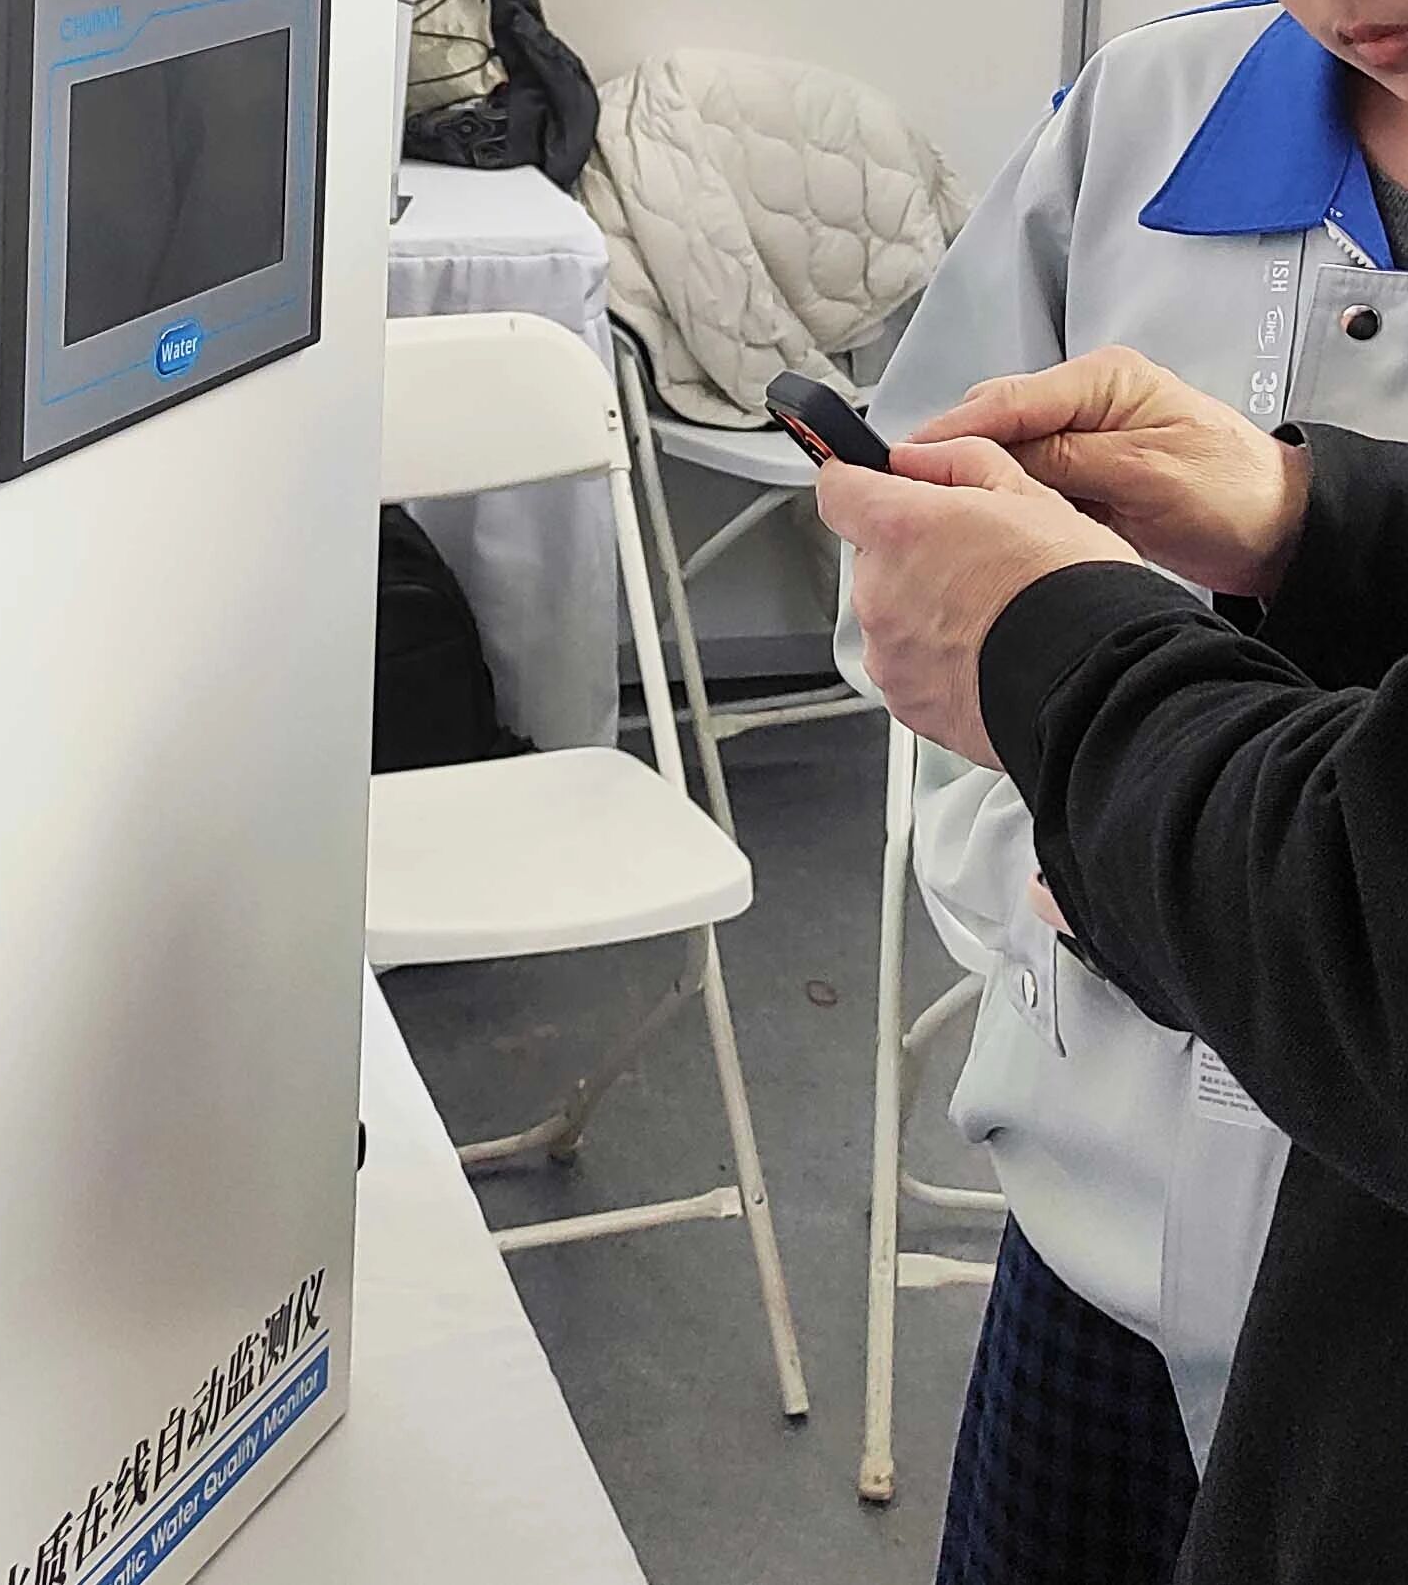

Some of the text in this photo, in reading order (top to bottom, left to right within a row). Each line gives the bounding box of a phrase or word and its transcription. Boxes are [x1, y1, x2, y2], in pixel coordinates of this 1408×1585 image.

[160, 332, 198, 364] Water
[149, 1366, 322, 1557] Water Quality Monitor
